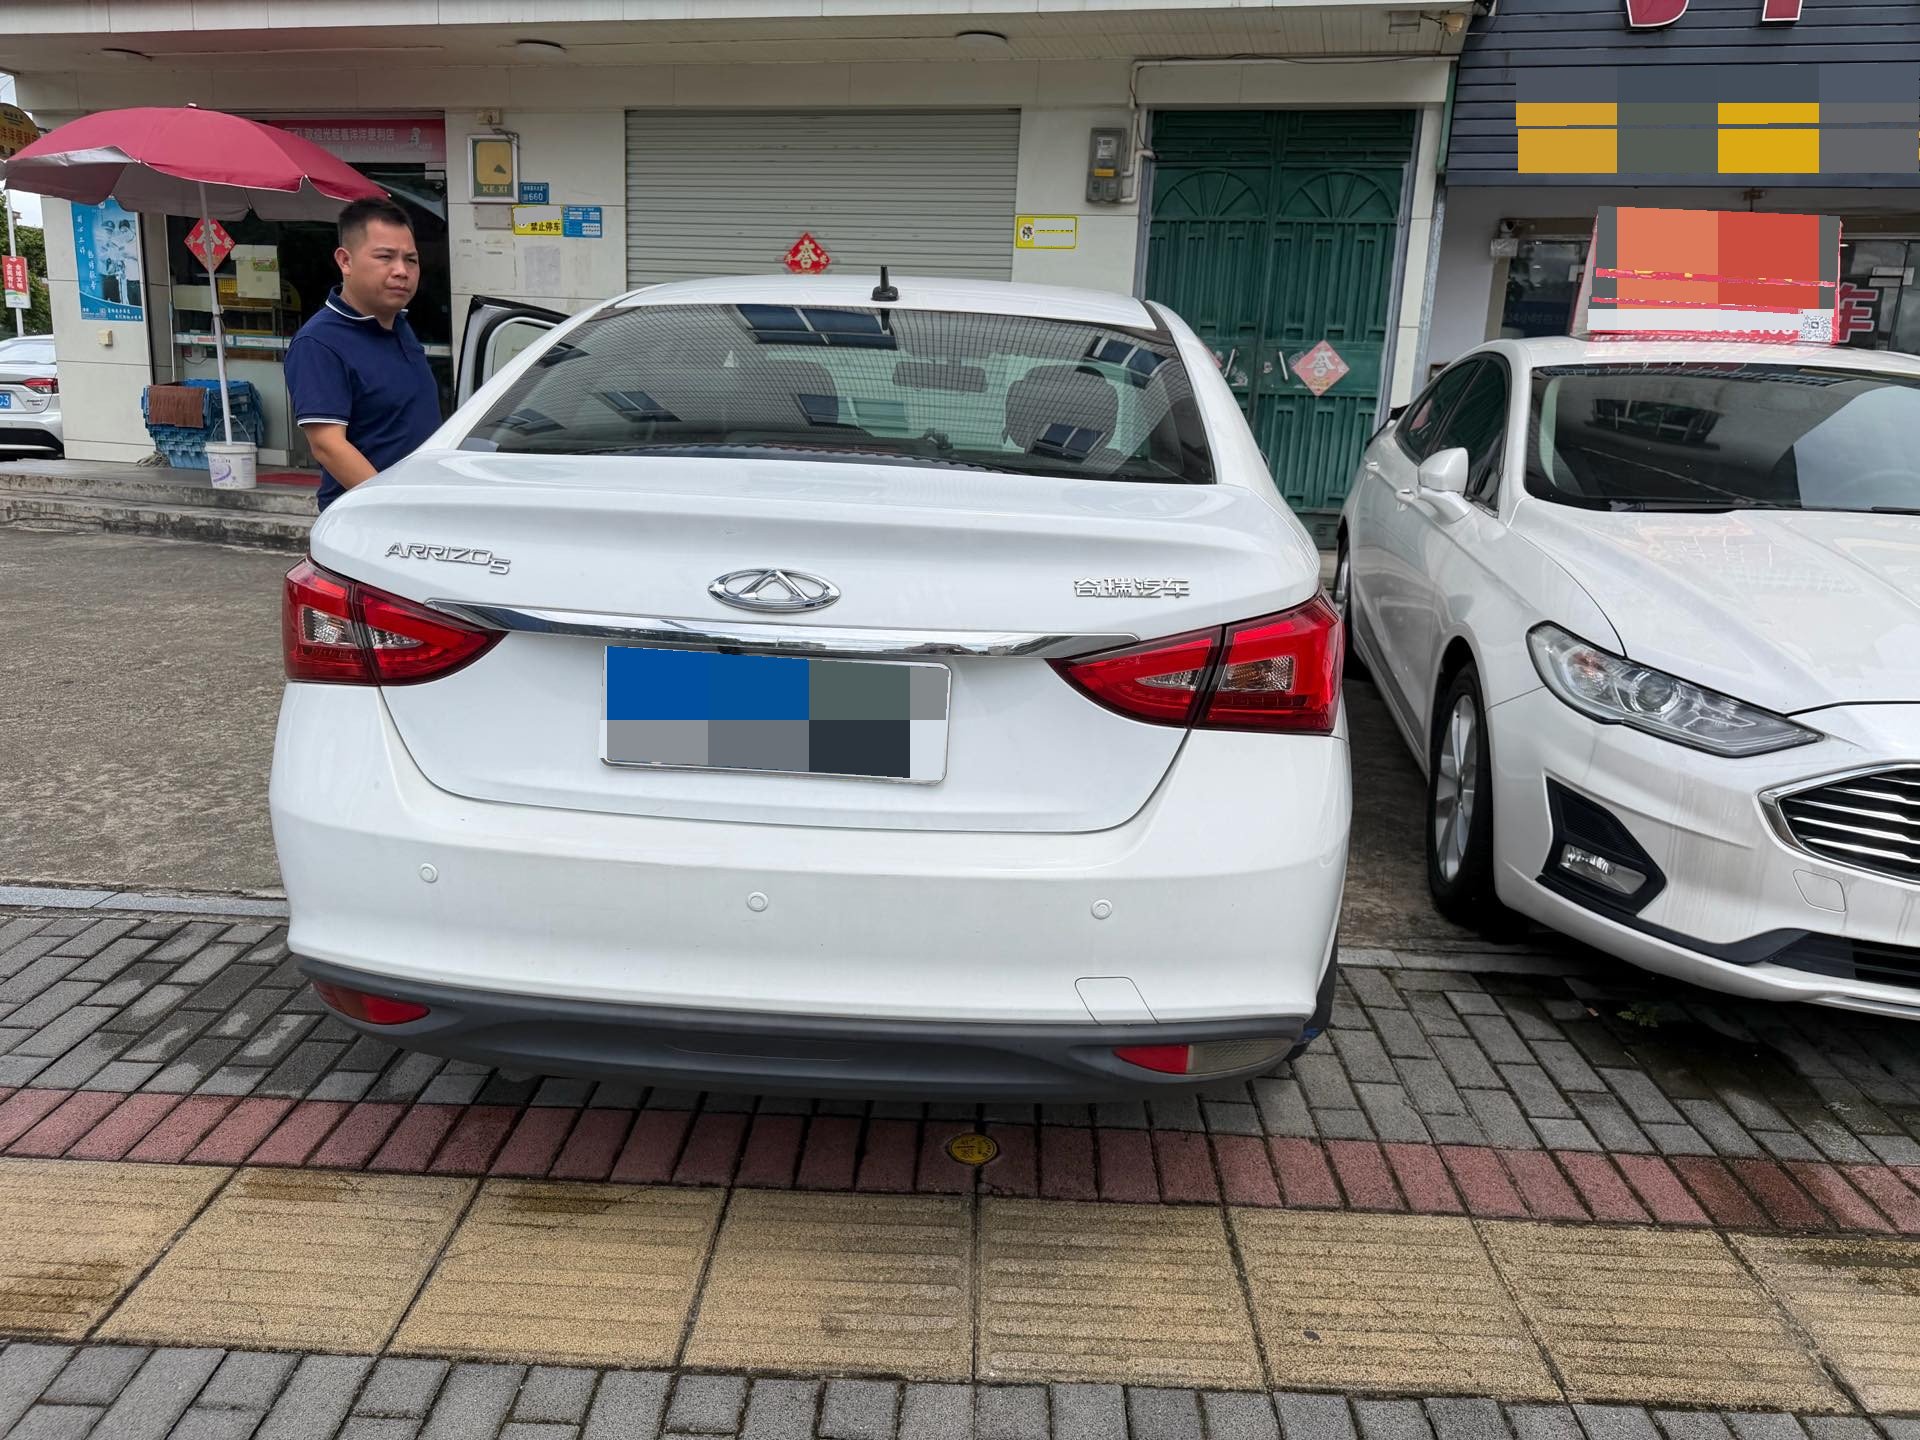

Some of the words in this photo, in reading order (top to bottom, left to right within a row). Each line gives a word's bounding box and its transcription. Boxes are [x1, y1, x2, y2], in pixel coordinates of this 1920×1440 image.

[530, 222, 561, 232] 禁止停车
[1074, 577, 1190, 598] 奇瑞汽车
